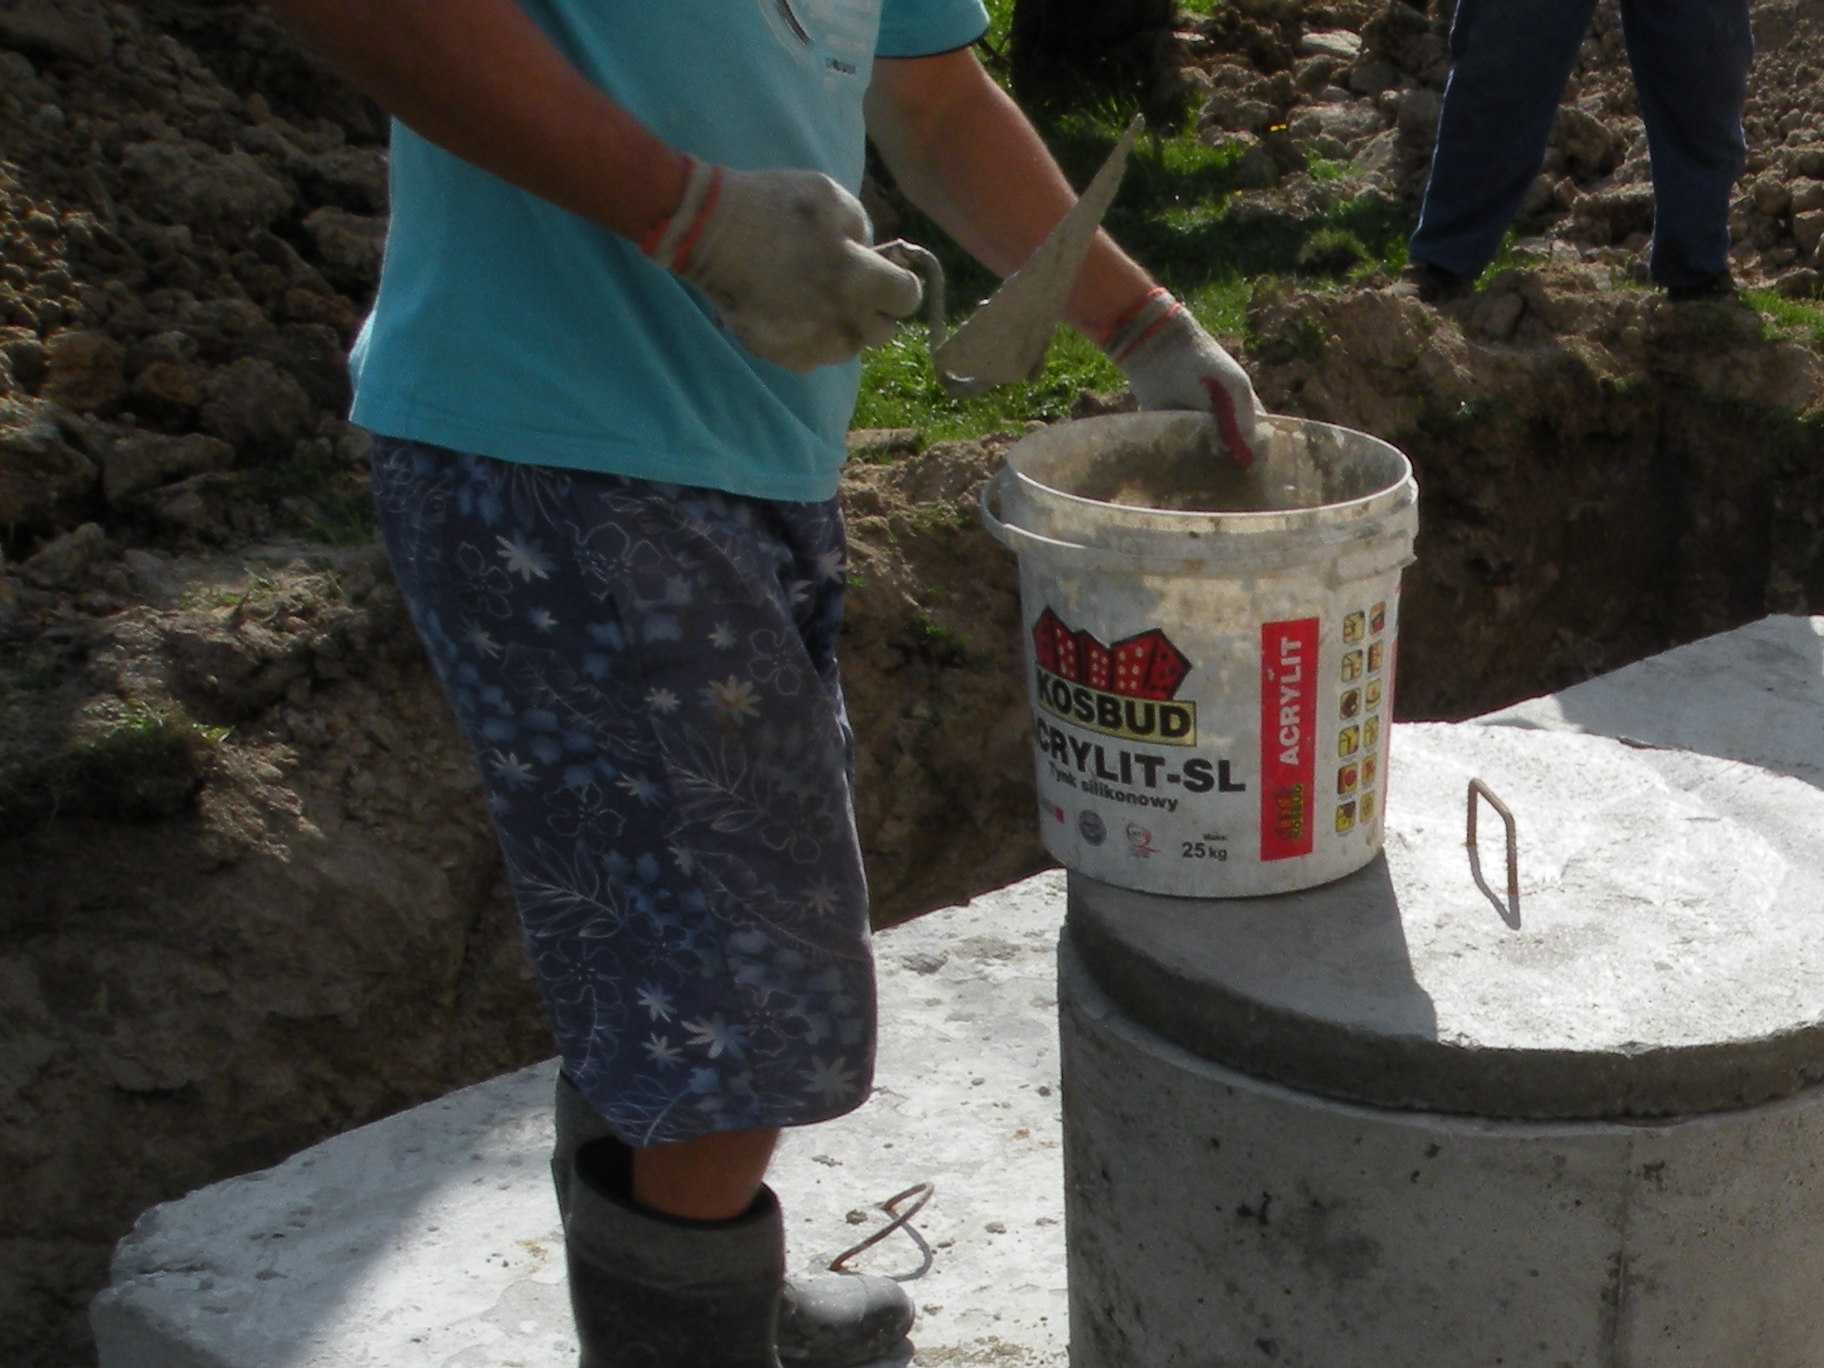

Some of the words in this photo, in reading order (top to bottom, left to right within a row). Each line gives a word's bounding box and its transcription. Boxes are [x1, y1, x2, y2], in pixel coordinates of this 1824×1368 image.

[1036, 666, 1192, 738] KOSBUD
[1279, 637, 1302, 765] ACRYLIT
[1036, 717, 1247, 793] CRYLIT-SL
[1081, 779, 1179, 813] silikonowy
[1181, 841, 1206, 859] 25
[1208, 846, 1228, 861] kg
